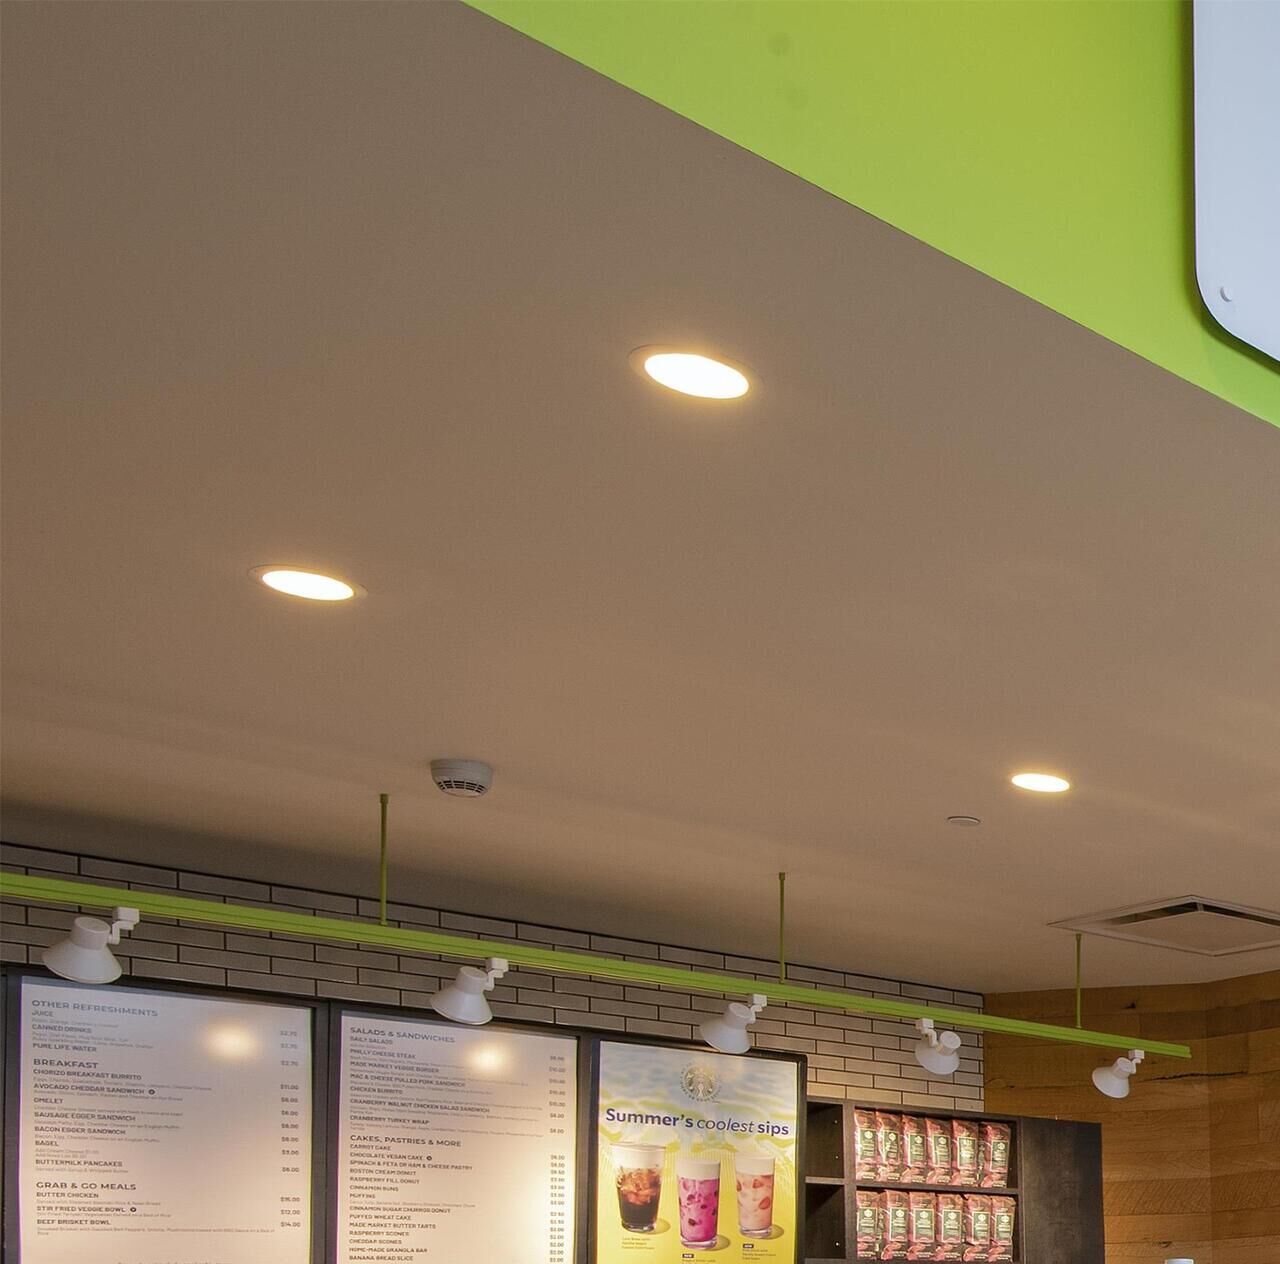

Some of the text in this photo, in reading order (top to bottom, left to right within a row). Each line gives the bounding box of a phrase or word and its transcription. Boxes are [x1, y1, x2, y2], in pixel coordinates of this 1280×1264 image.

[32, 1000, 158, 1016] OTHER REFRESHMENTS
[351, 1027, 385, 1037] SALADS
[397, 1031, 455, 1043] SANDWICHES
[372, 1050, 396, 1058] CHEESE
[34, 1058, 98, 1069] BREAKFAST
[67, 1070, 109, 1079] BREAKFAST
[106, 1087, 144, 1095] SANDWICH
[606, 1108, 790, 1137] Summer’s coolest sips
[350, 1134, 382, 1143] CAKES,
[385, 1136, 426, 1145] PASTRIES
